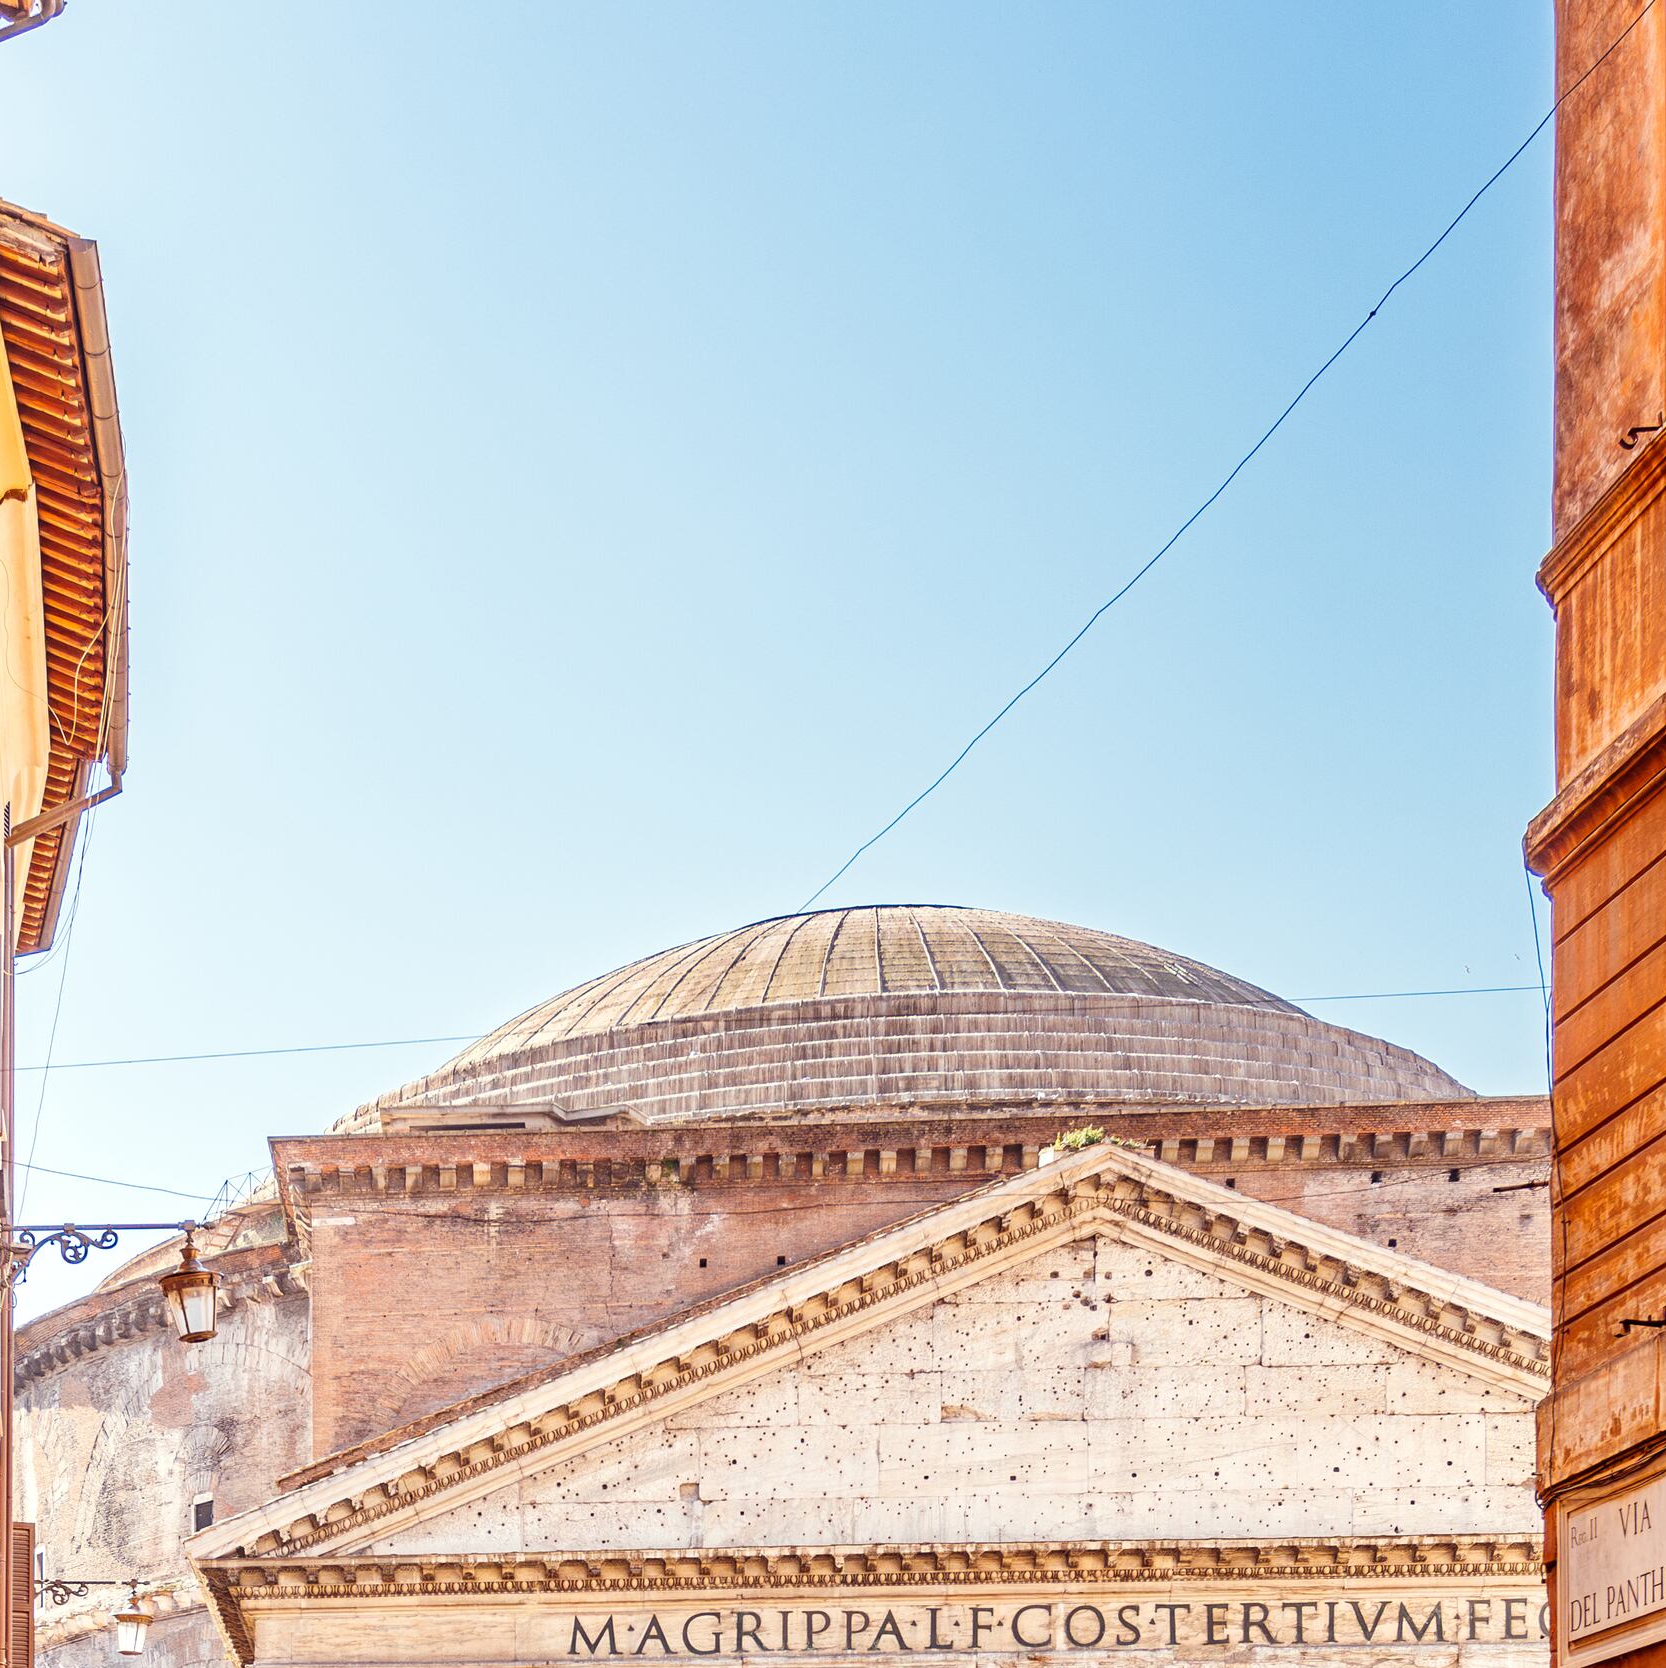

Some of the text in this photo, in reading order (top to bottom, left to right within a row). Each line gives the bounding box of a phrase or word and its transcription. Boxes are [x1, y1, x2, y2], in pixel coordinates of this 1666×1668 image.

[1619, 1500, 1652, 1538] VIA
[1465, 1597, 1549, 1640] FE
[1570, 1592, 1601, 1633] DEL
